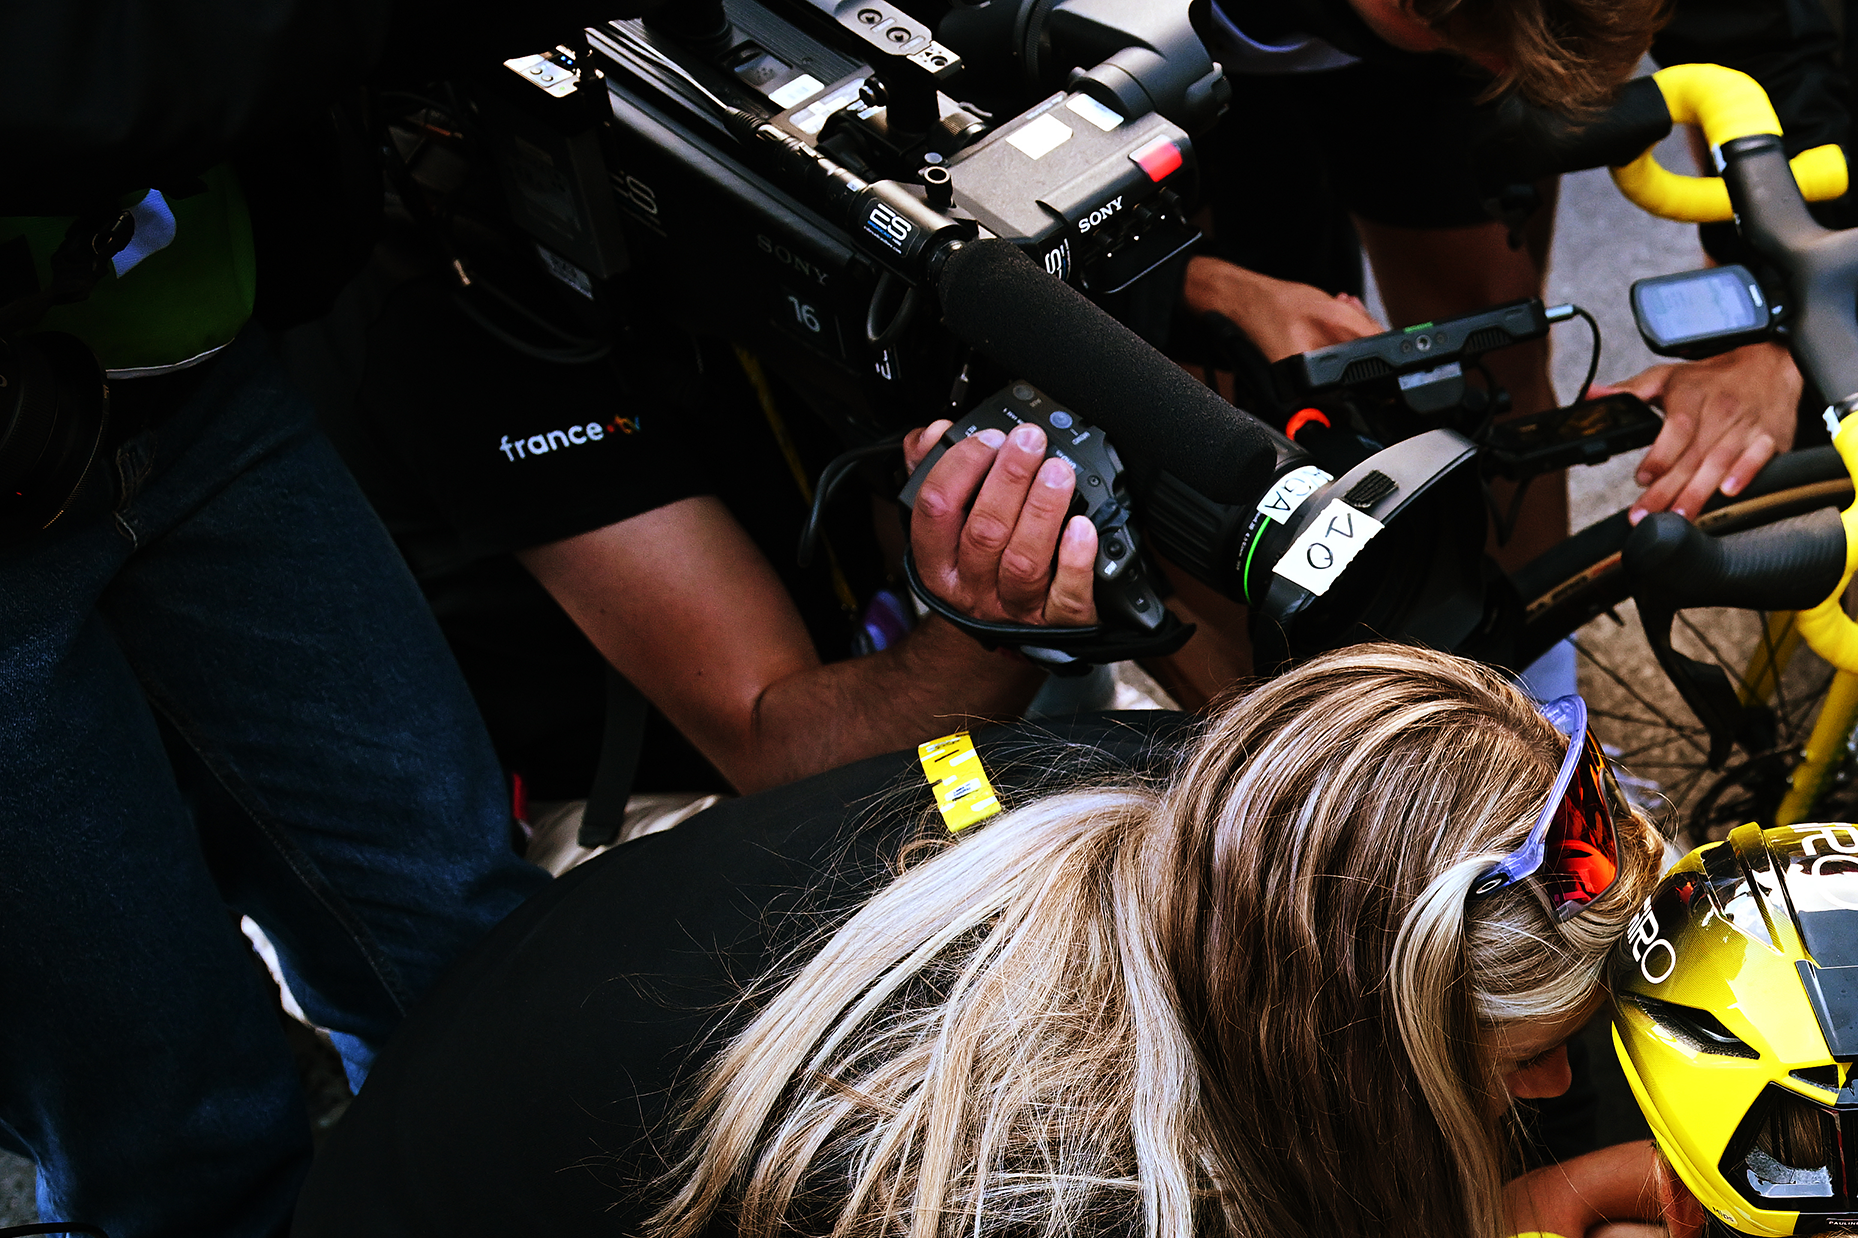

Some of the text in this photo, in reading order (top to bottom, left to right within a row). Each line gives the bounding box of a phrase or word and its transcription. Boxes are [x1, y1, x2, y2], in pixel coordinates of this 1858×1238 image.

[869, 203, 912, 241] ES
[1078, 195, 1123, 234] SONY
[756, 234, 830, 287] SONY
[787, 295, 822, 333] 16
